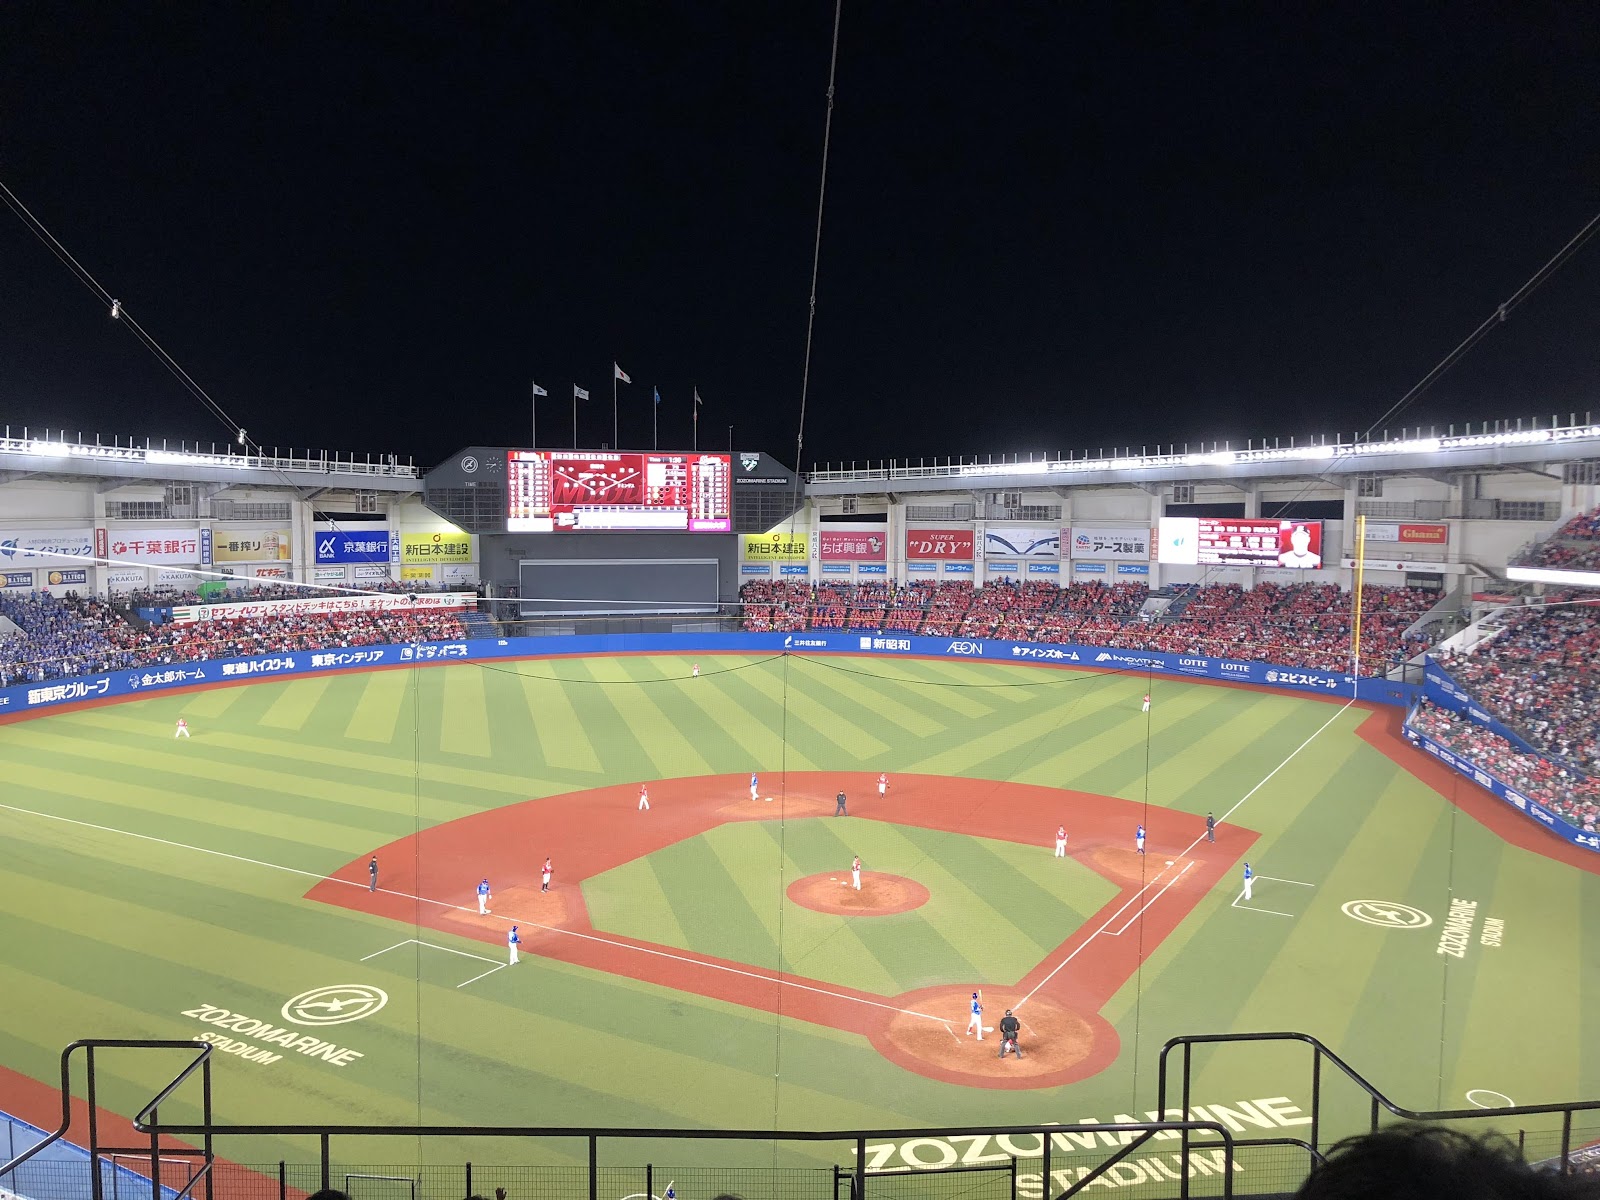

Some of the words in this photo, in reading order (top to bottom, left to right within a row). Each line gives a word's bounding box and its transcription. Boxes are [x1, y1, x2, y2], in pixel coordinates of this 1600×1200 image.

[1402, 529, 1440, 539] Ghana
[24, 545, 92, 557] エイジェック
[129, 539, 196, 555] 千葉銀行
[217, 541, 261, 552] 一番搾り
[343, 541, 388, 553] 京葉銀行
[405, 543, 469, 555] 新日本建設
[747, 543, 805, 554] 新日本建設
[822, 542, 867, 554] ちば興銀
[1093, 542, 1145, 554] アース製薬
[256, 568, 285, 577] サビキラー
[873, 638, 911, 651] 新昭和
[311, 650, 384, 667] 東京インテリア
[1021, 647, 1080, 661] アインズホーム
[222, 658, 295, 676] 東進ハイスクール
[1179, 658, 1208, 667] LOTTE
[1220, 662, 1250, 672] LOTTE
[141, 667, 206, 687] 金太郎ホーム
[1279, 672, 1337, 689] ヱビスビール
[28, 677, 110, 705] 新東京グループ
[1437, 897, 1477, 958] ZOZOMARINE
[1480, 917, 1504, 947] STADIUM
[181, 1003, 364, 1067] ZOZOMARINE
[192, 1032, 283, 1065] STADIUM
[851, 1096, 1314, 1173] ZOZOMARINE
[1016, 1149, 1244, 1200] STADIUM
